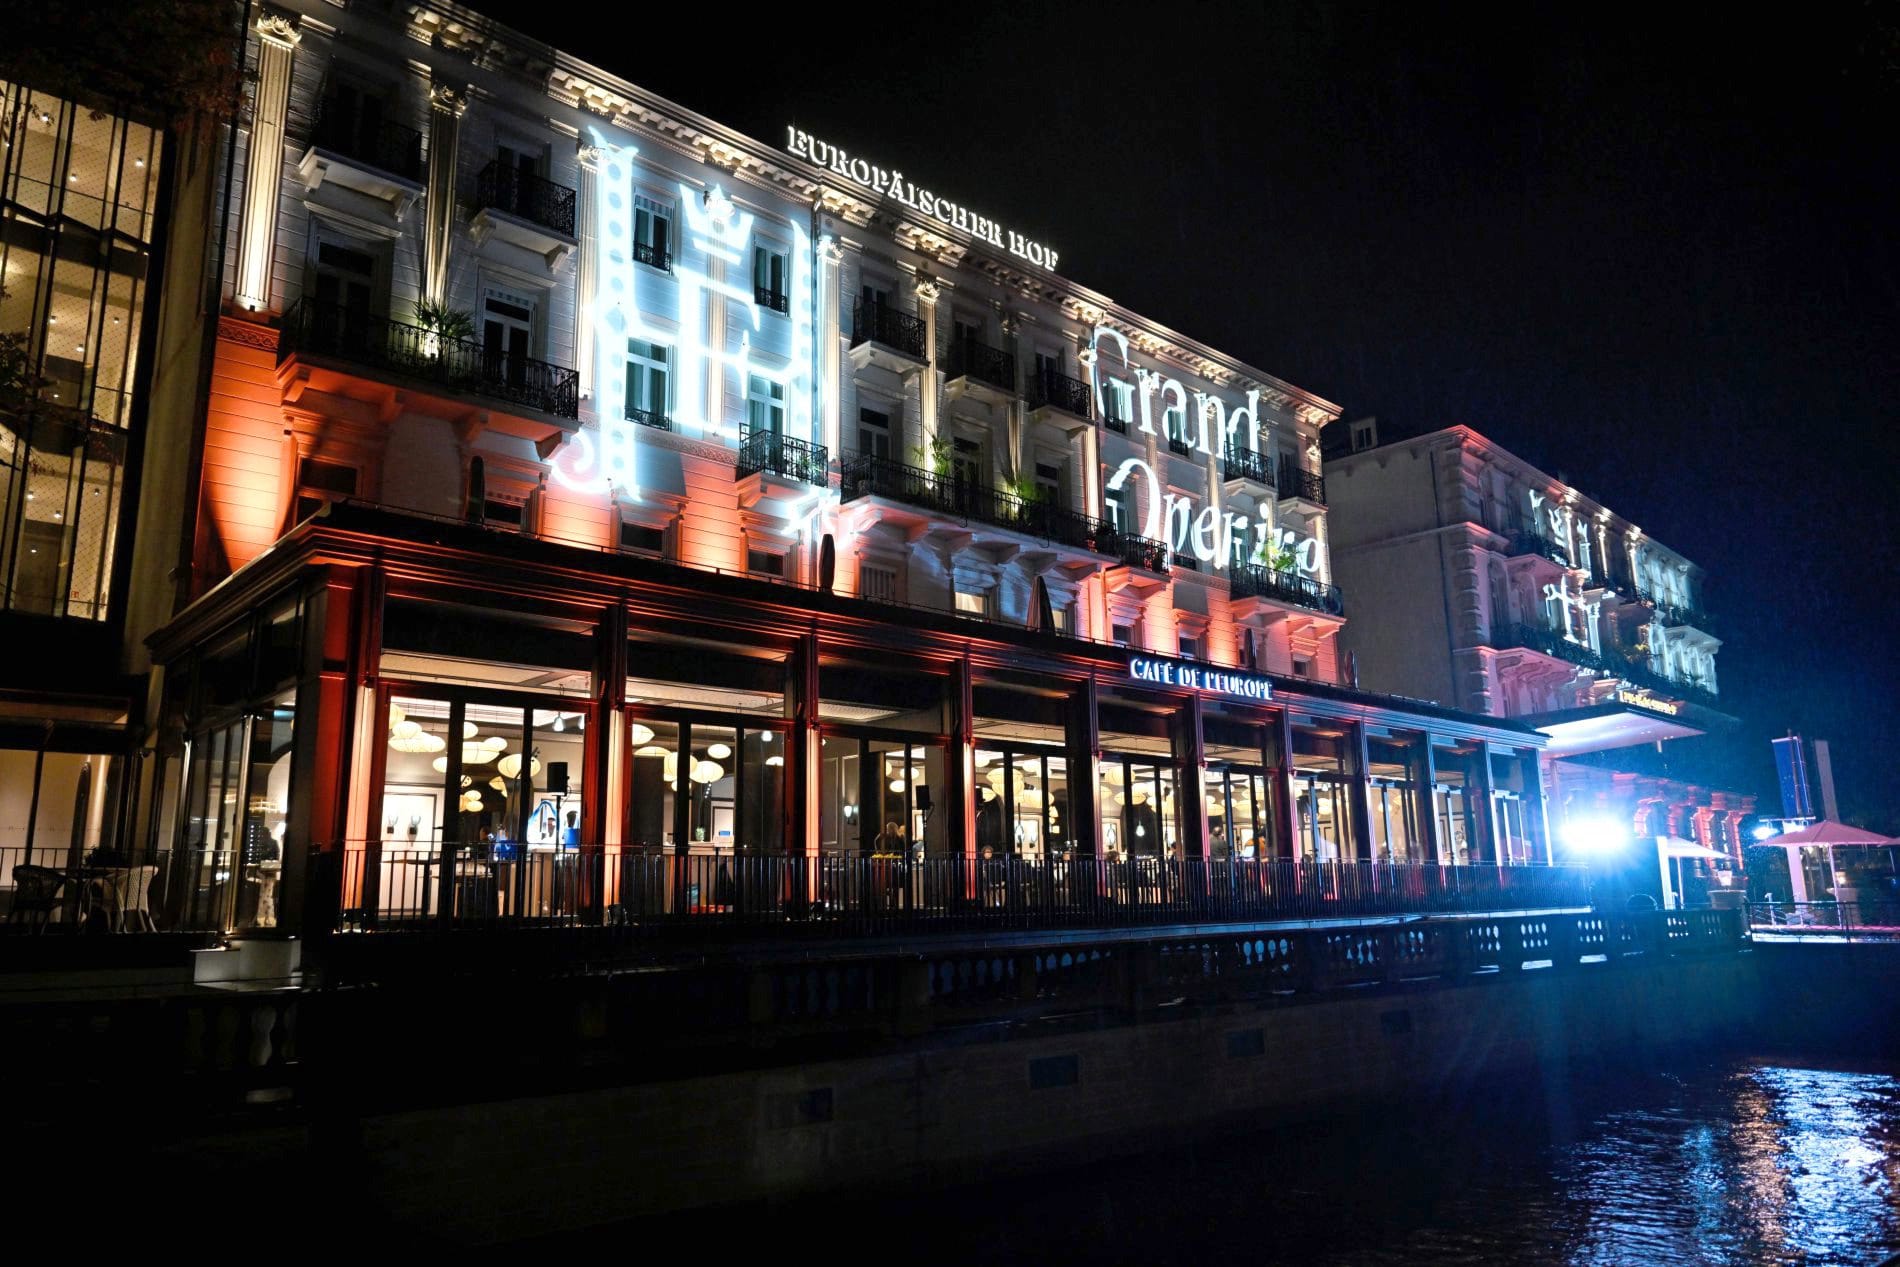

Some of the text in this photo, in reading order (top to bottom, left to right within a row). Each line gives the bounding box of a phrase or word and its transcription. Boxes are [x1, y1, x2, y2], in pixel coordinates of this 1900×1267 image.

[787, 126, 1059, 271] EUROPÄISCHER HOF
[1089, 326, 1260, 460] Grand
[1178, 666, 1201, 688] DE
